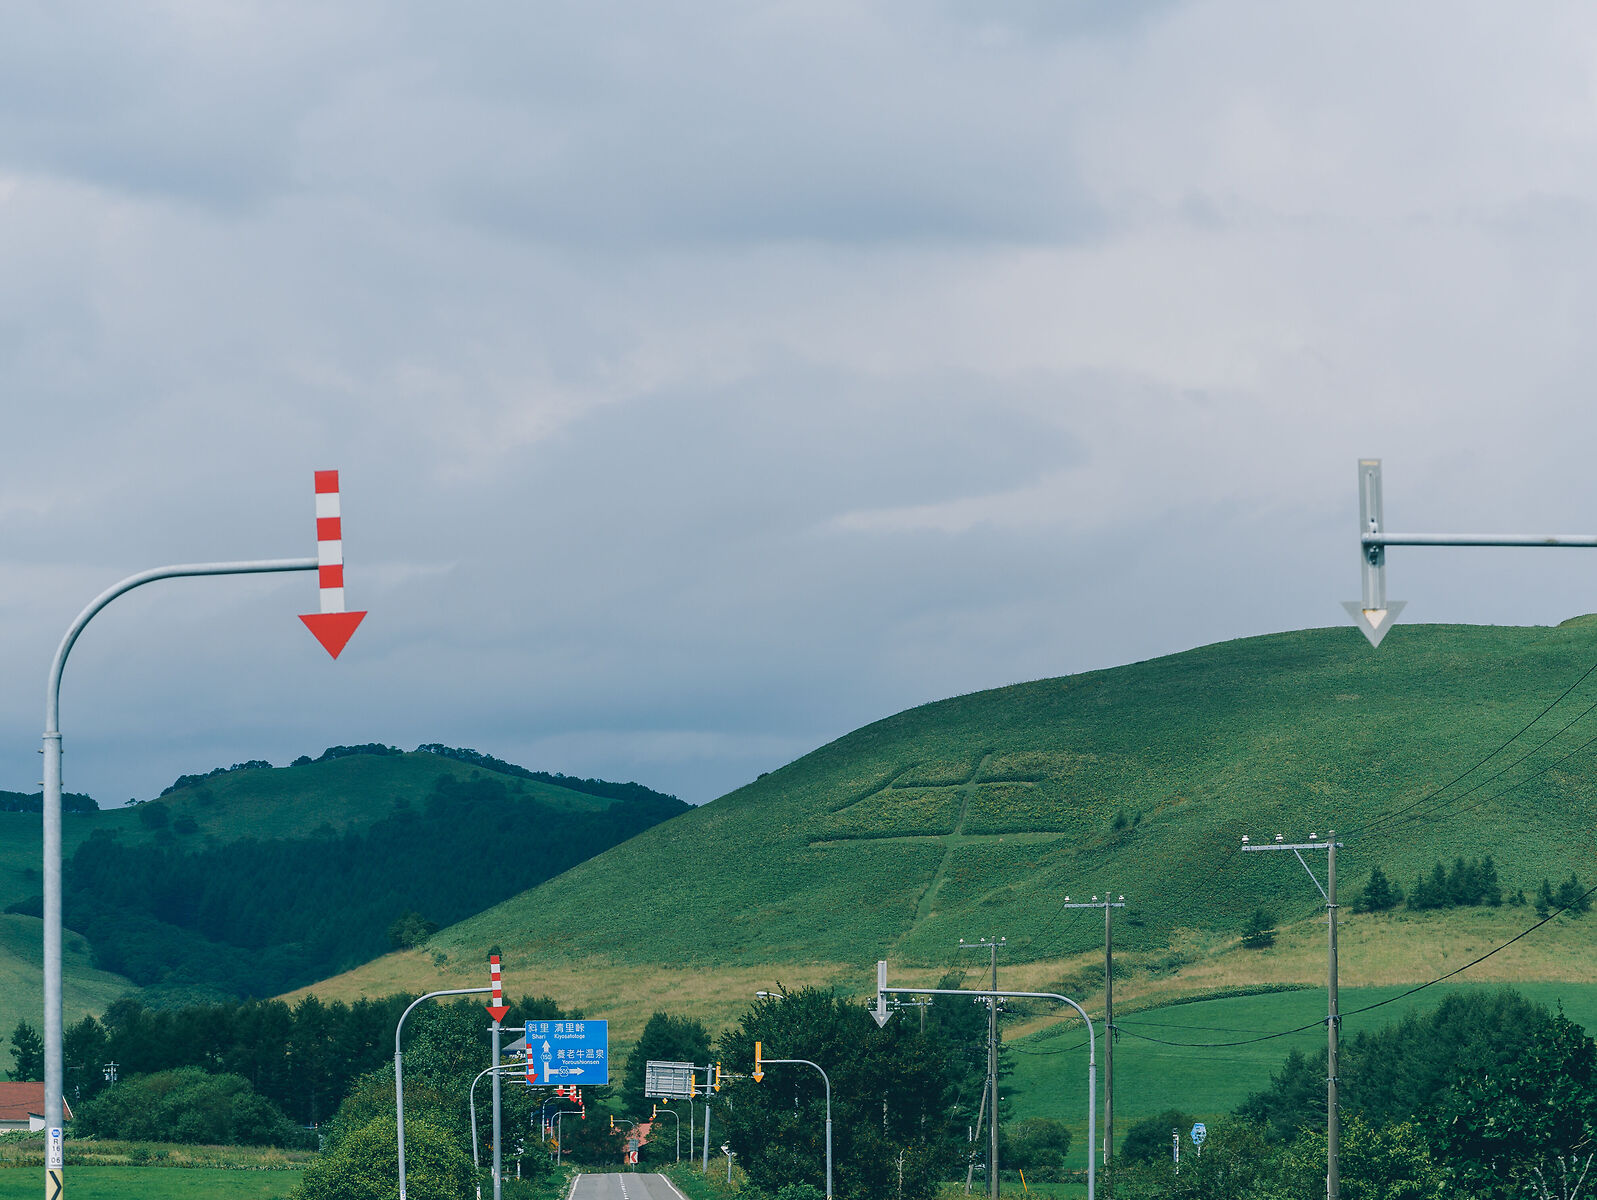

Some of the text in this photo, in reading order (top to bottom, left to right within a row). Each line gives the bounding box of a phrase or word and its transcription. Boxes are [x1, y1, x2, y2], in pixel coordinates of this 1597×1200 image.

[528, 1023, 585, 1033] 斜里 清里峠
[557, 1049, 604, 1059] 養老牛温泉
